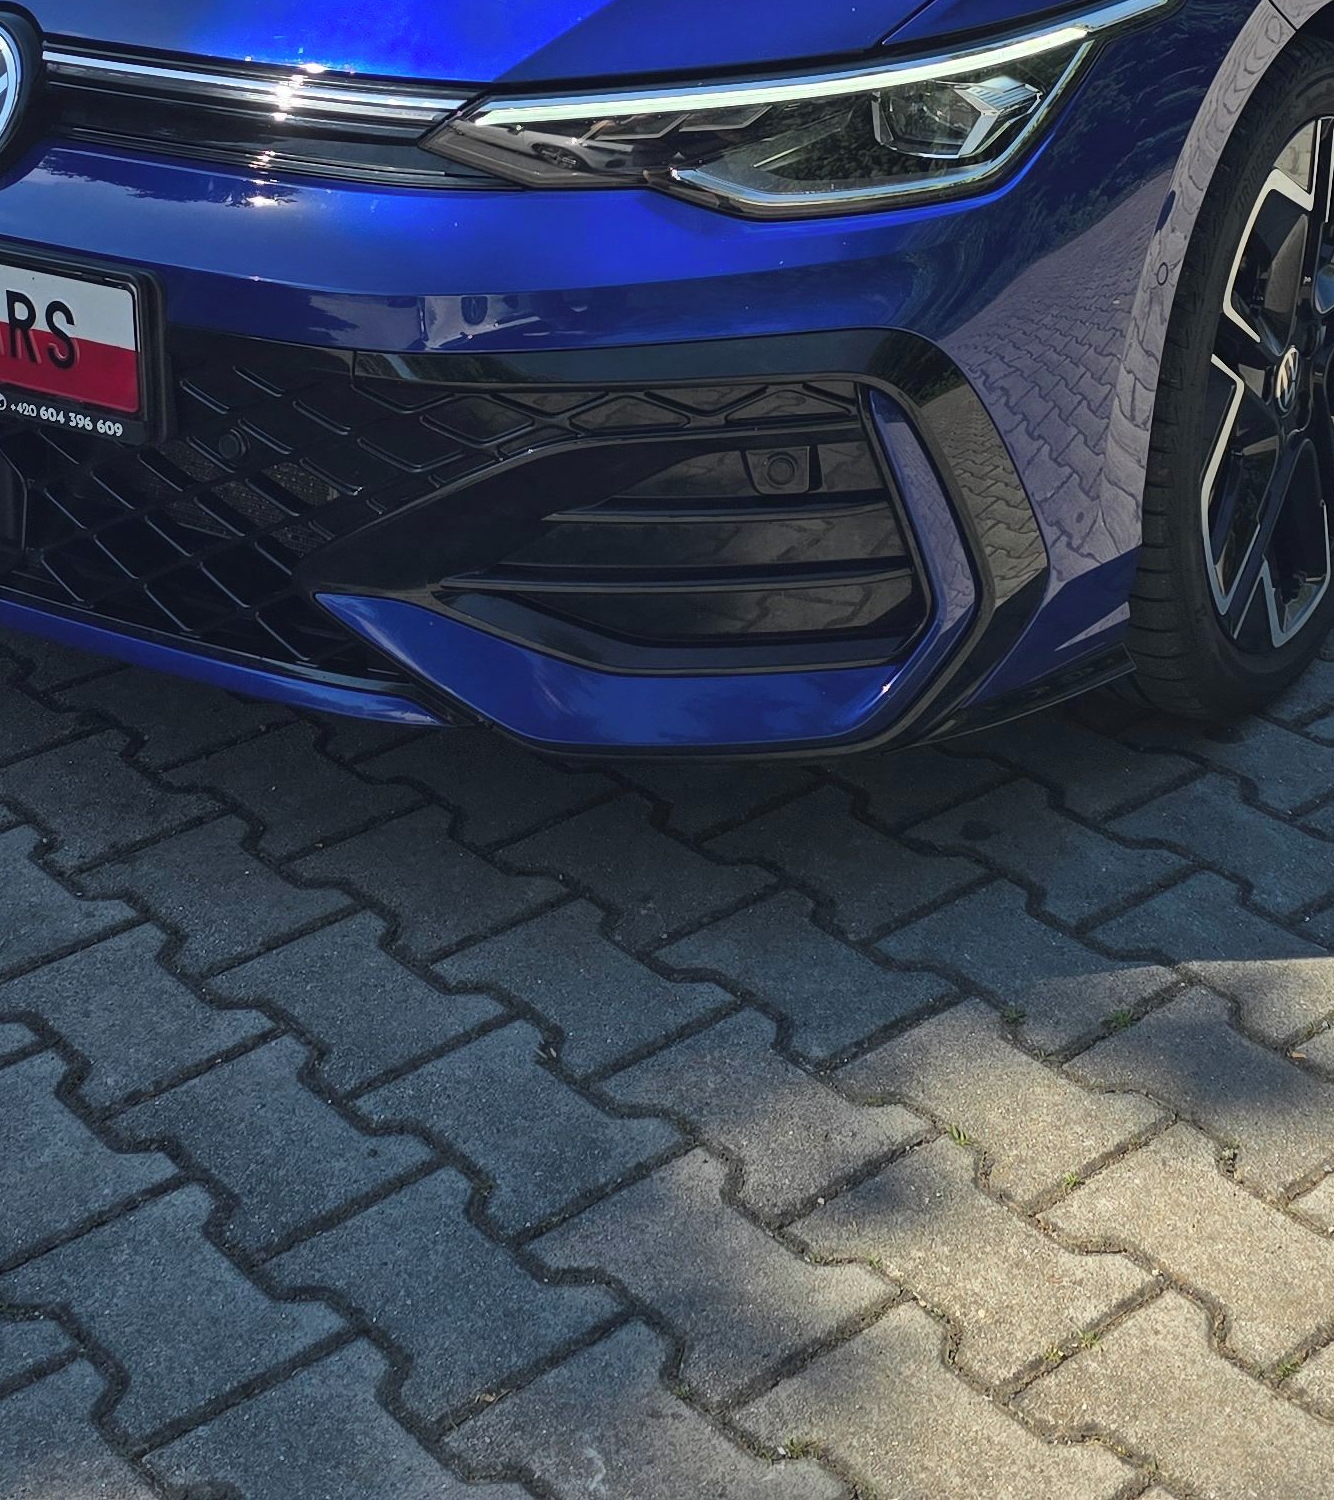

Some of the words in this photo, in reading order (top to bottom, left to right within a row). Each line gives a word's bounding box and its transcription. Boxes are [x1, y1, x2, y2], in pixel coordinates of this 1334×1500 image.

[10, 402, 37, 417] +420
[39, 406, 66, 424] 604
[68, 412, 93, 431] 396
[96, 419, 123, 437] 609
